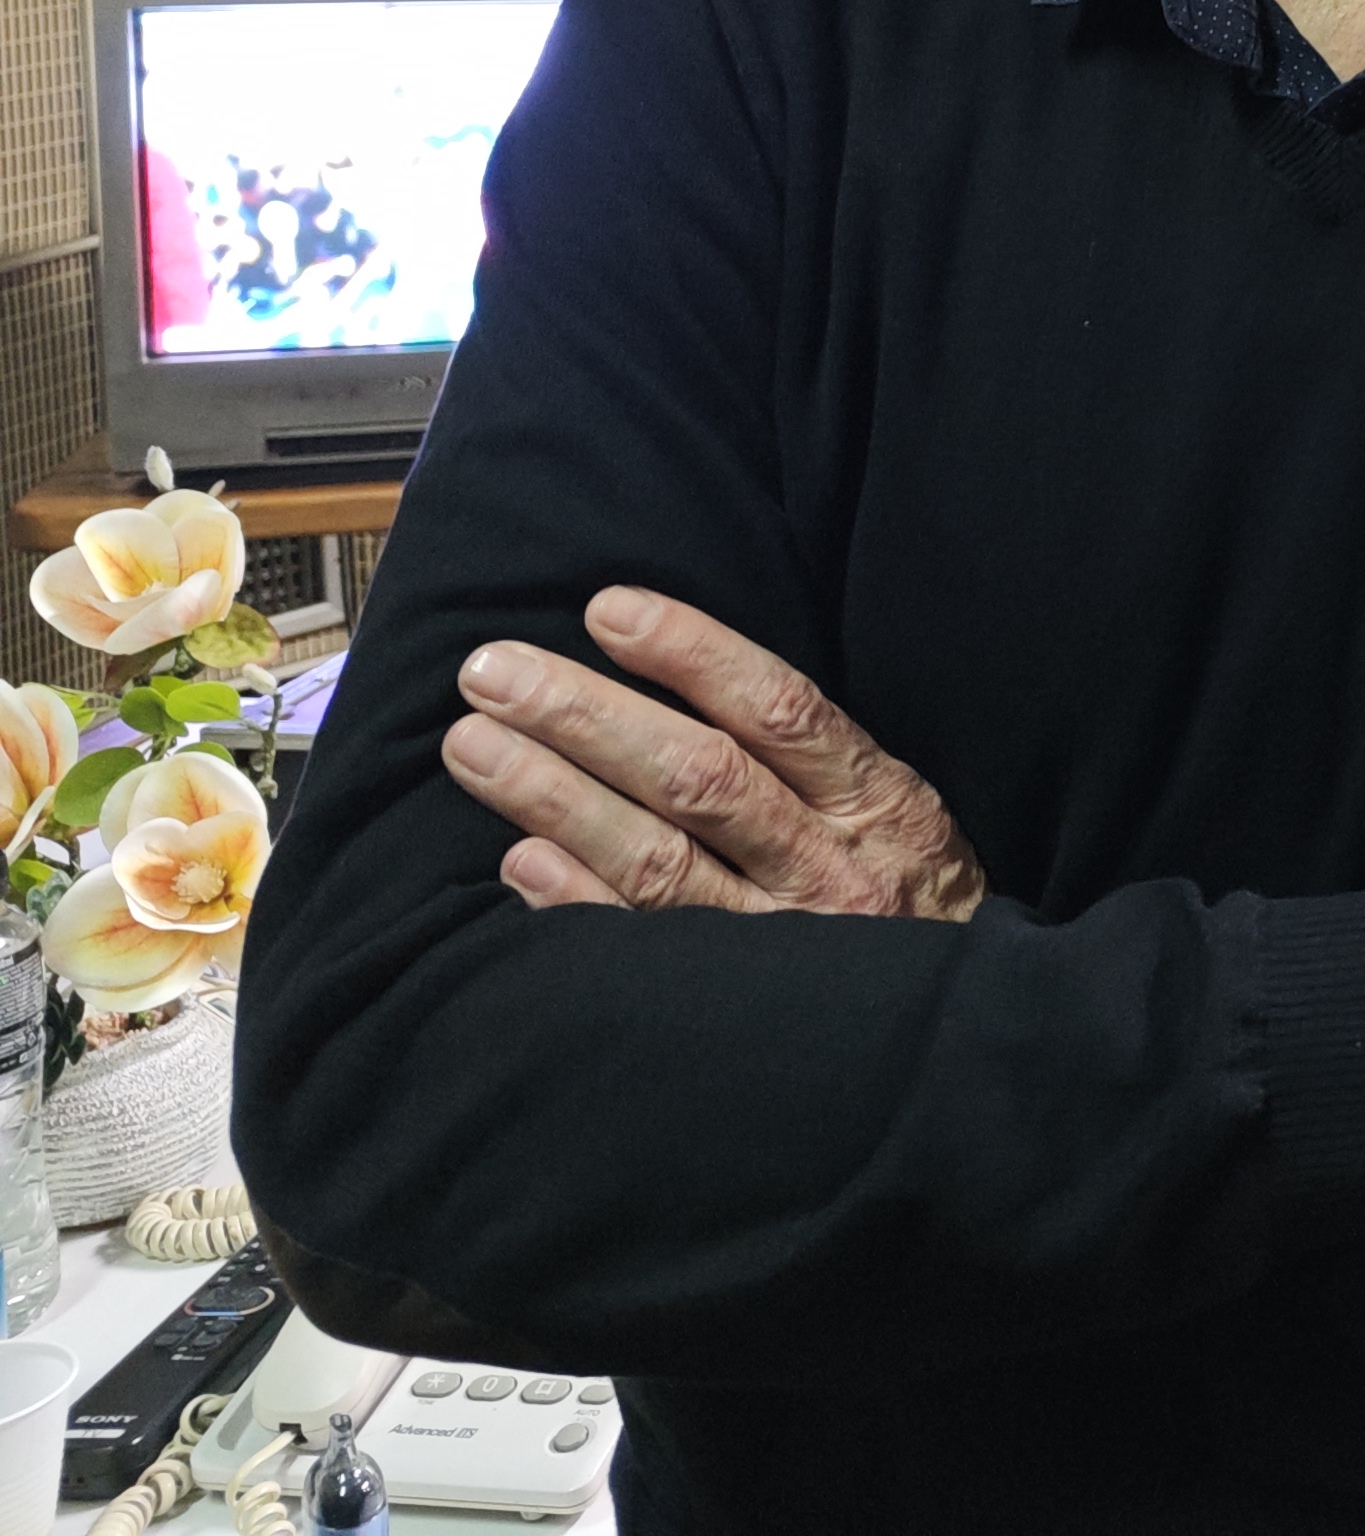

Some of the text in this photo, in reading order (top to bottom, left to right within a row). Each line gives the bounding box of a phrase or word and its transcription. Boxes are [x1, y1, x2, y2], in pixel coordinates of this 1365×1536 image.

[481, 1376, 499, 1393] 0
[75, 1415, 138, 1424] SONY
[388, 1423, 457, 1438] Advanced
